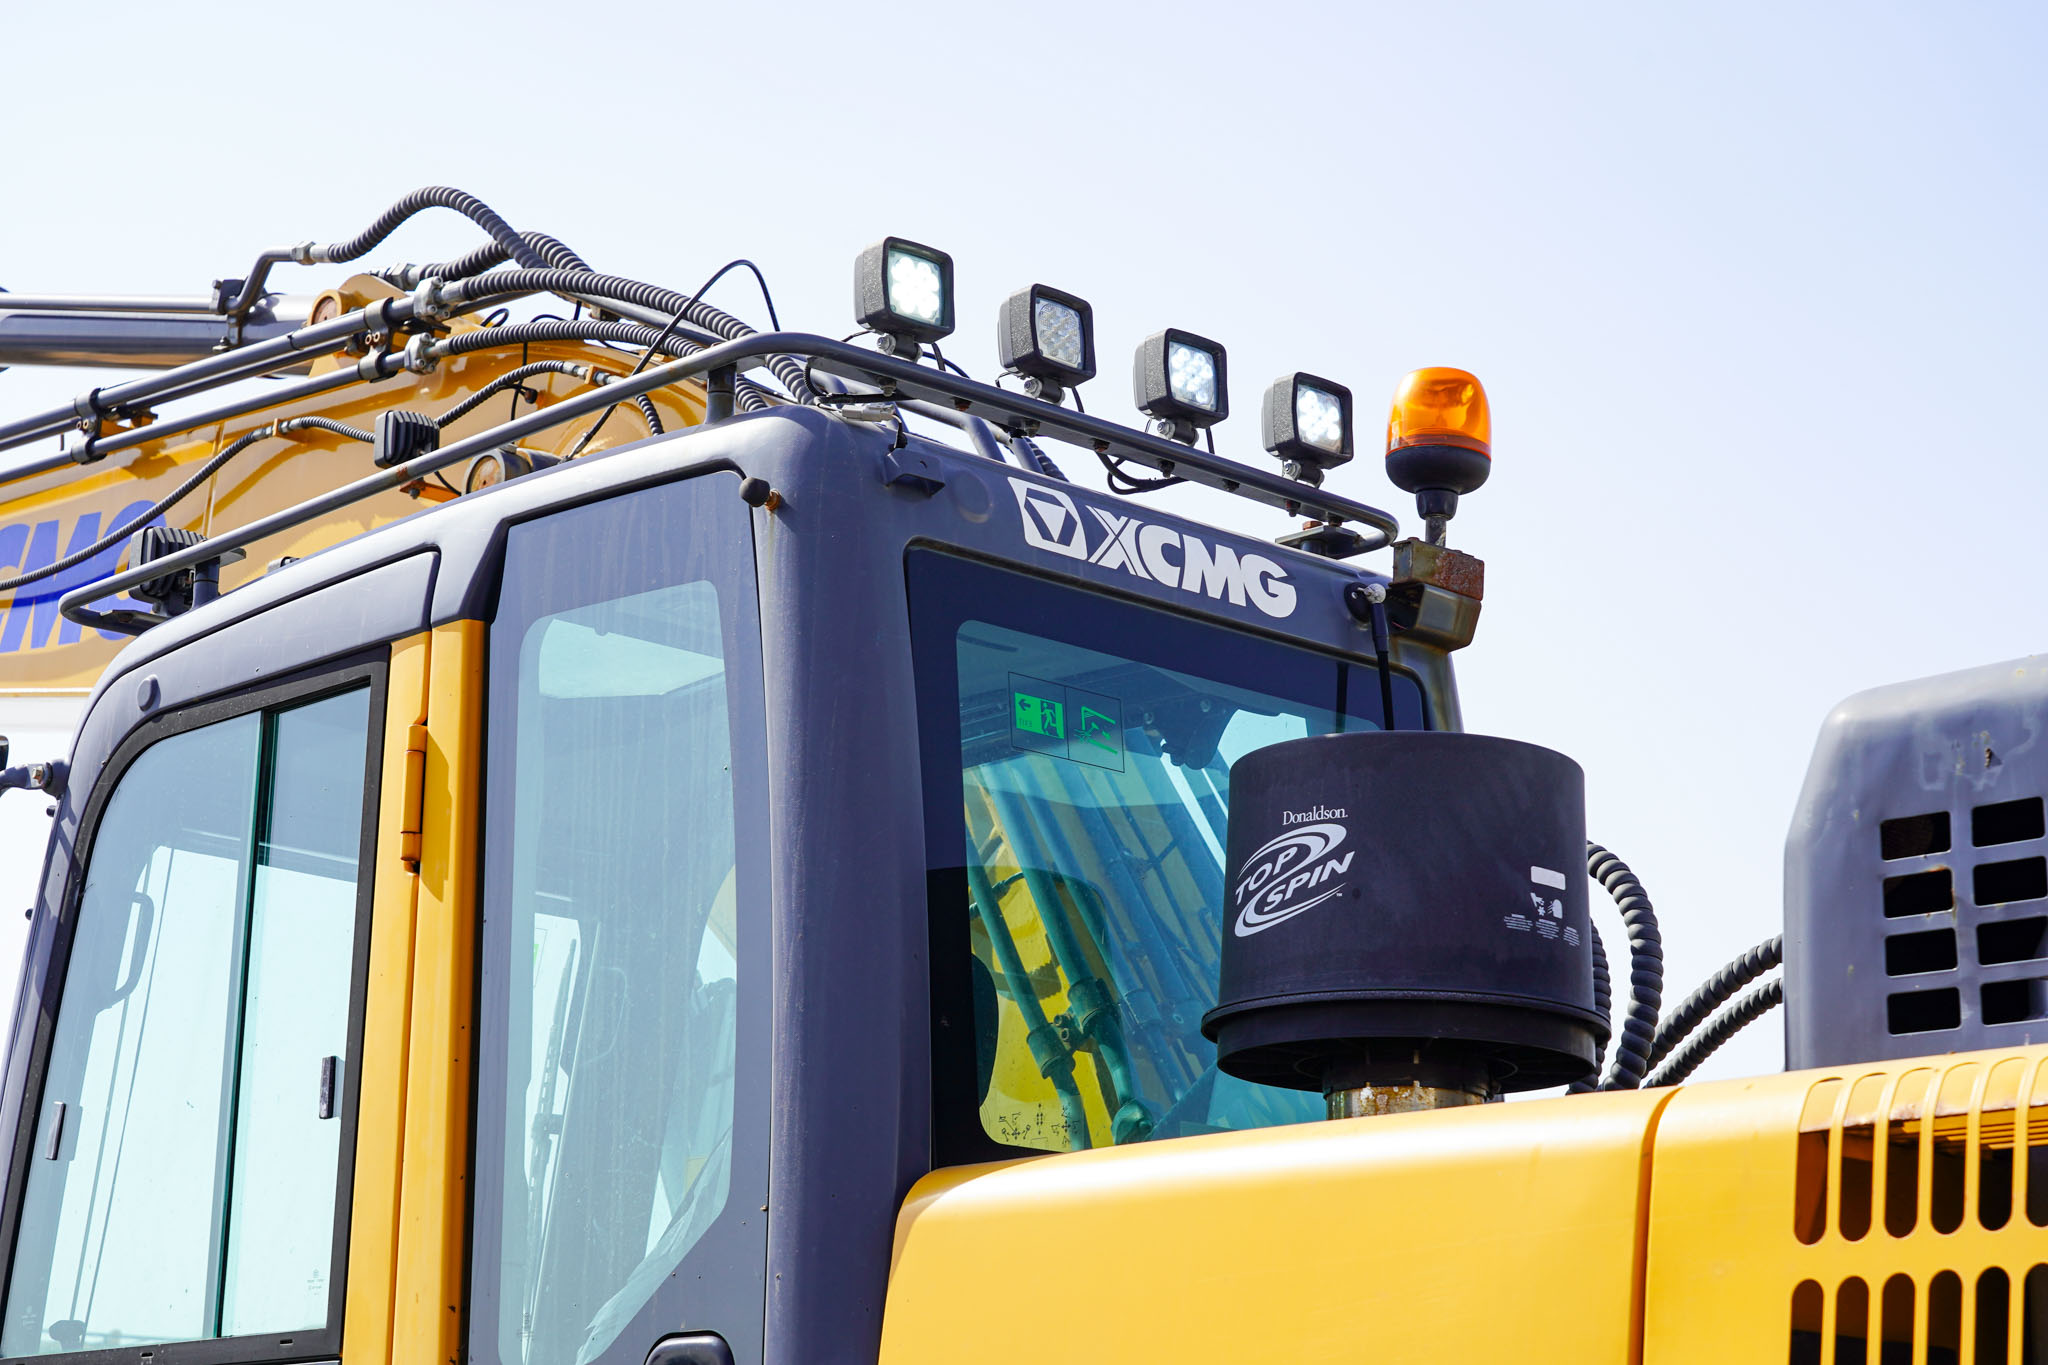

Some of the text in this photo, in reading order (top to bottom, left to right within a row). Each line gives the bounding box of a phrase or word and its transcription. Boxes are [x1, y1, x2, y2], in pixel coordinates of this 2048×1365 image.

[1086, 504, 1297, 618] XCMG
[1235, 846, 1298, 906] TOP
[1263, 851, 1356, 913] SPIN
